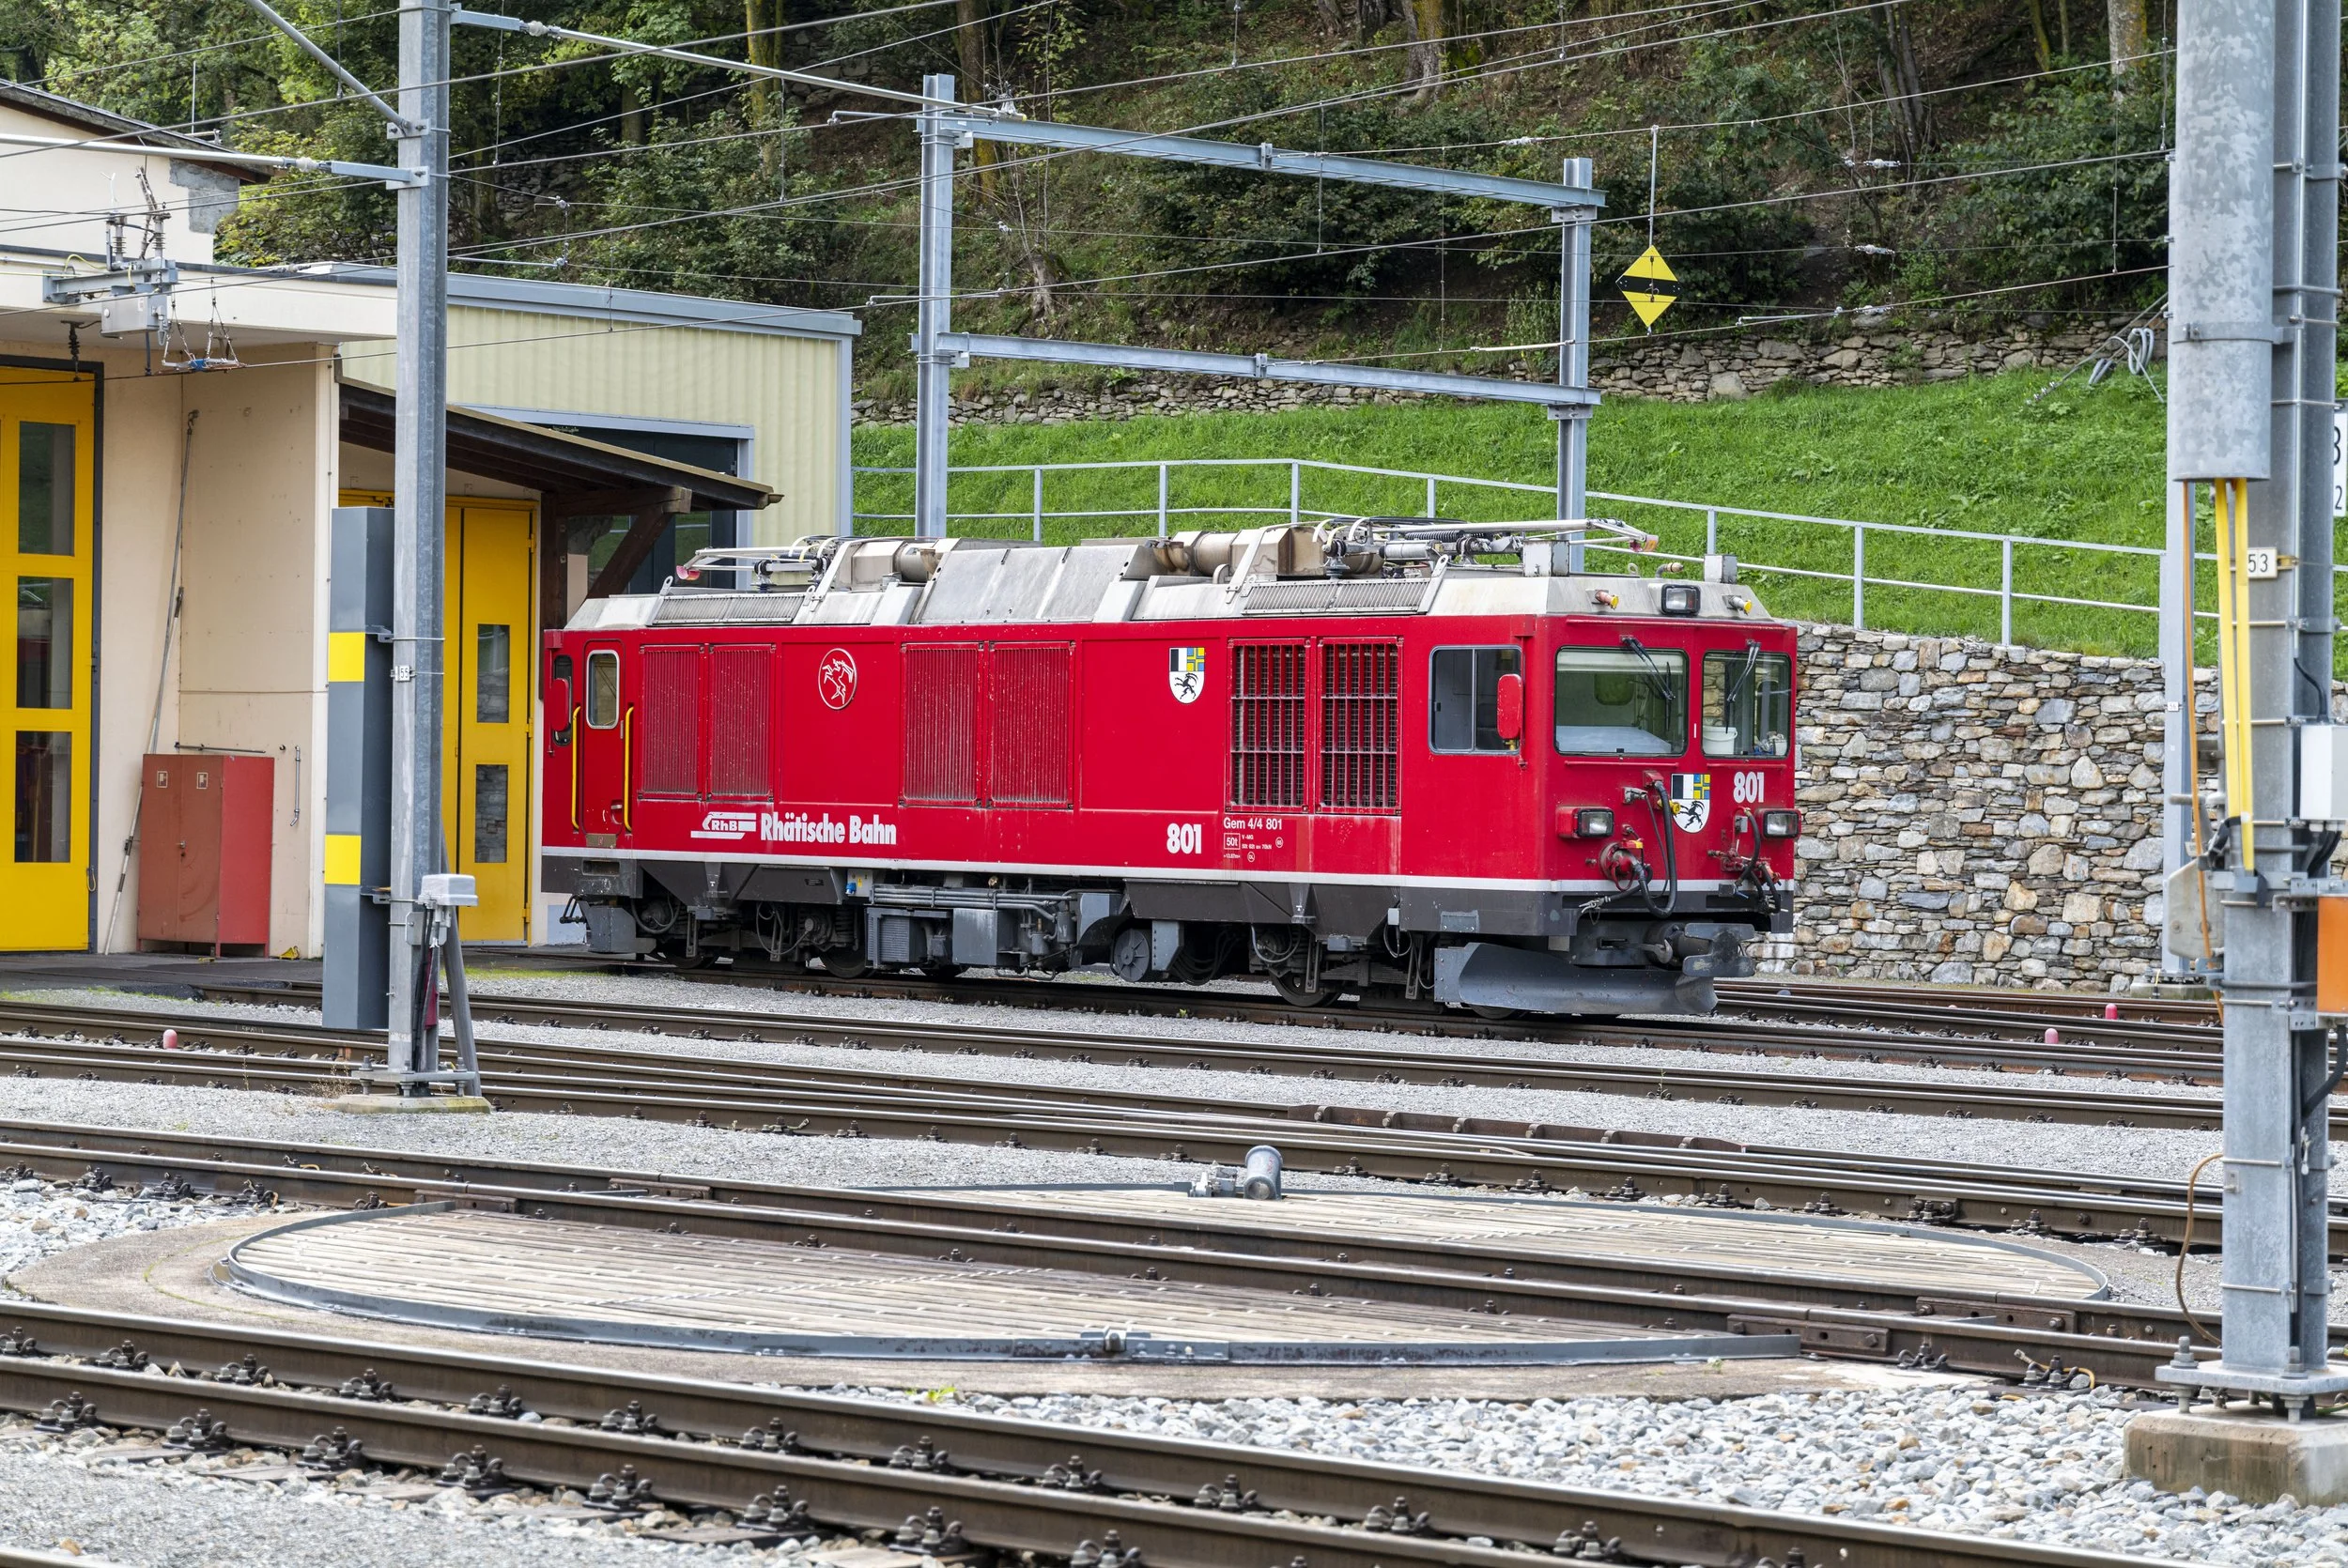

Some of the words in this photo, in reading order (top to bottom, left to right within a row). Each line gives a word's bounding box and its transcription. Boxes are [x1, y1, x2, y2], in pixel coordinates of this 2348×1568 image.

[2335, 485, 2342, 510] 2
[2248, 553, 2268, 573] 53
[1733, 771, 1765, 804] 801
[711, 820, 738, 832] RhB
[760, 812, 845, 844] Rhätische
[848, 814, 897, 845] Bahn
[1223, 817, 1246, 829] Gem
[1247, 817, 1263, 830] 4/4
[1265, 818, 1283, 830] 801
[1166, 822, 1202, 854] 801
[1226, 837, 1238, 847] 50t
